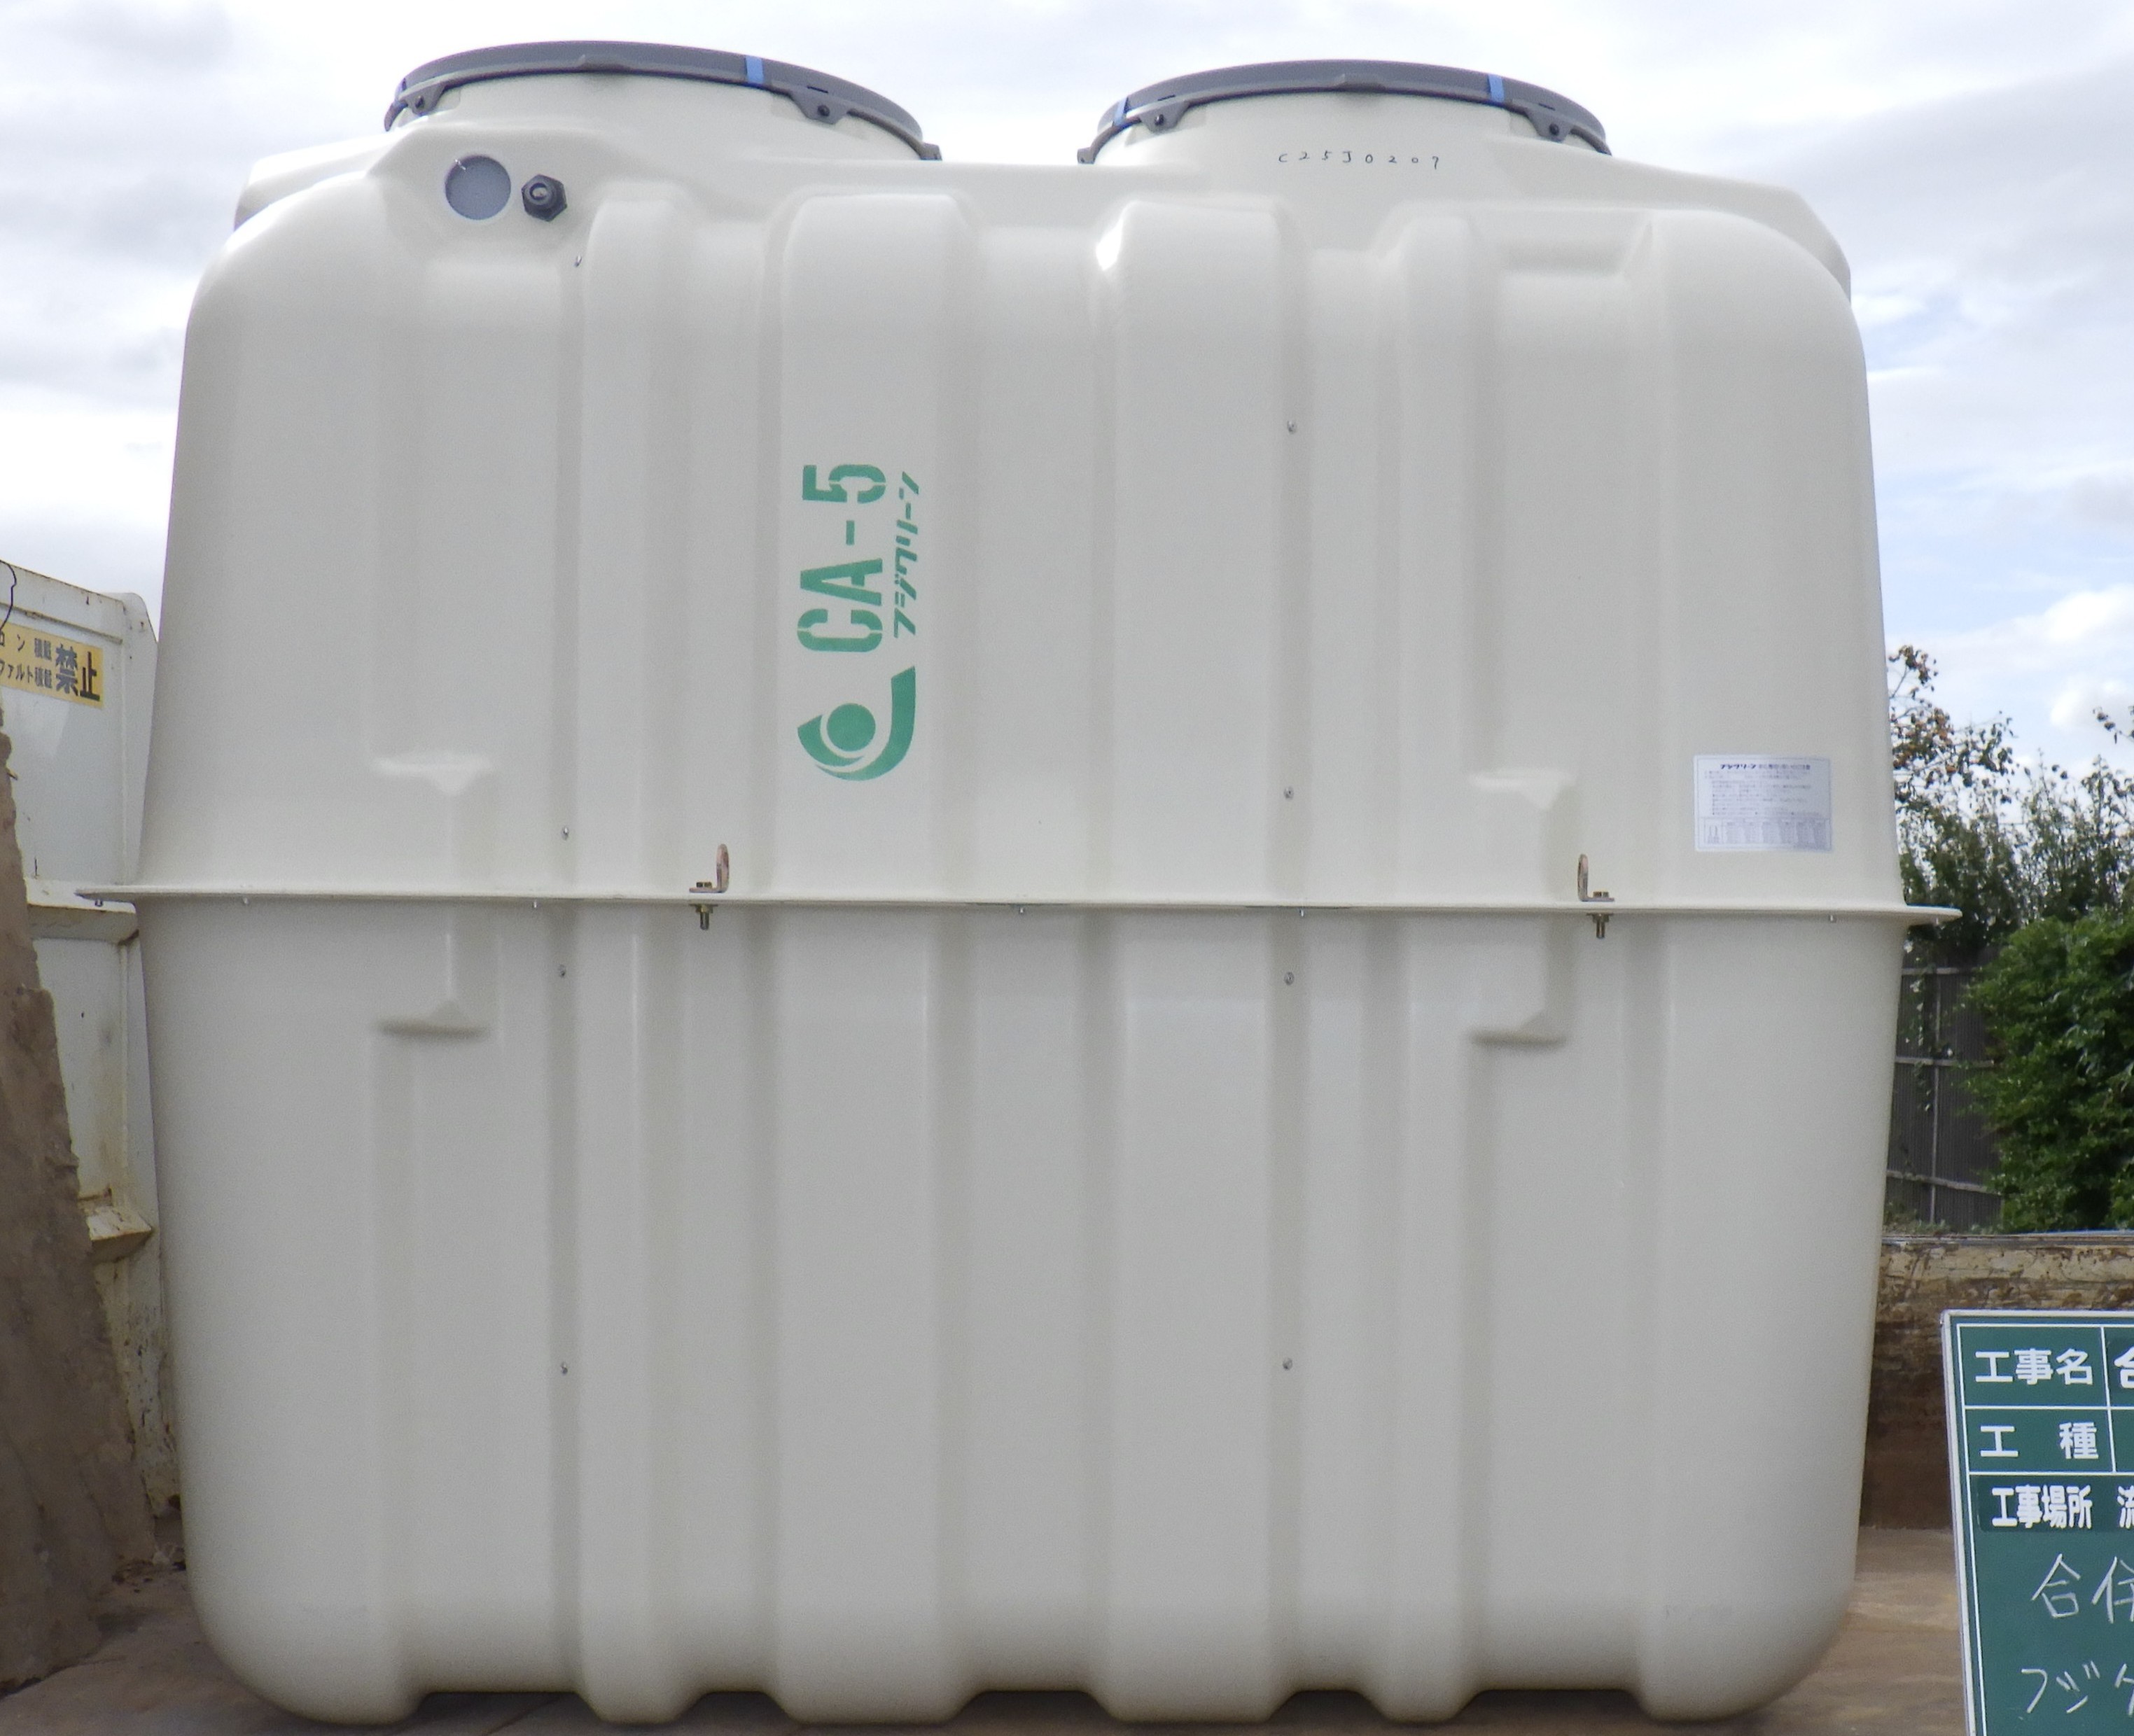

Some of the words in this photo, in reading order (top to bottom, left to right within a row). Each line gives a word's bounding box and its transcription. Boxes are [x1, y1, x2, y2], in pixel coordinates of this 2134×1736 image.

[797, 463, 886, 653] CA-5
[893, 470, 920, 639] フジクリーン
[55, 643, 101, 701] 禁止
[1975, 1348, 2094, 1386] 工事名
[1990, 1483, 2093, 1530] 工事場所
